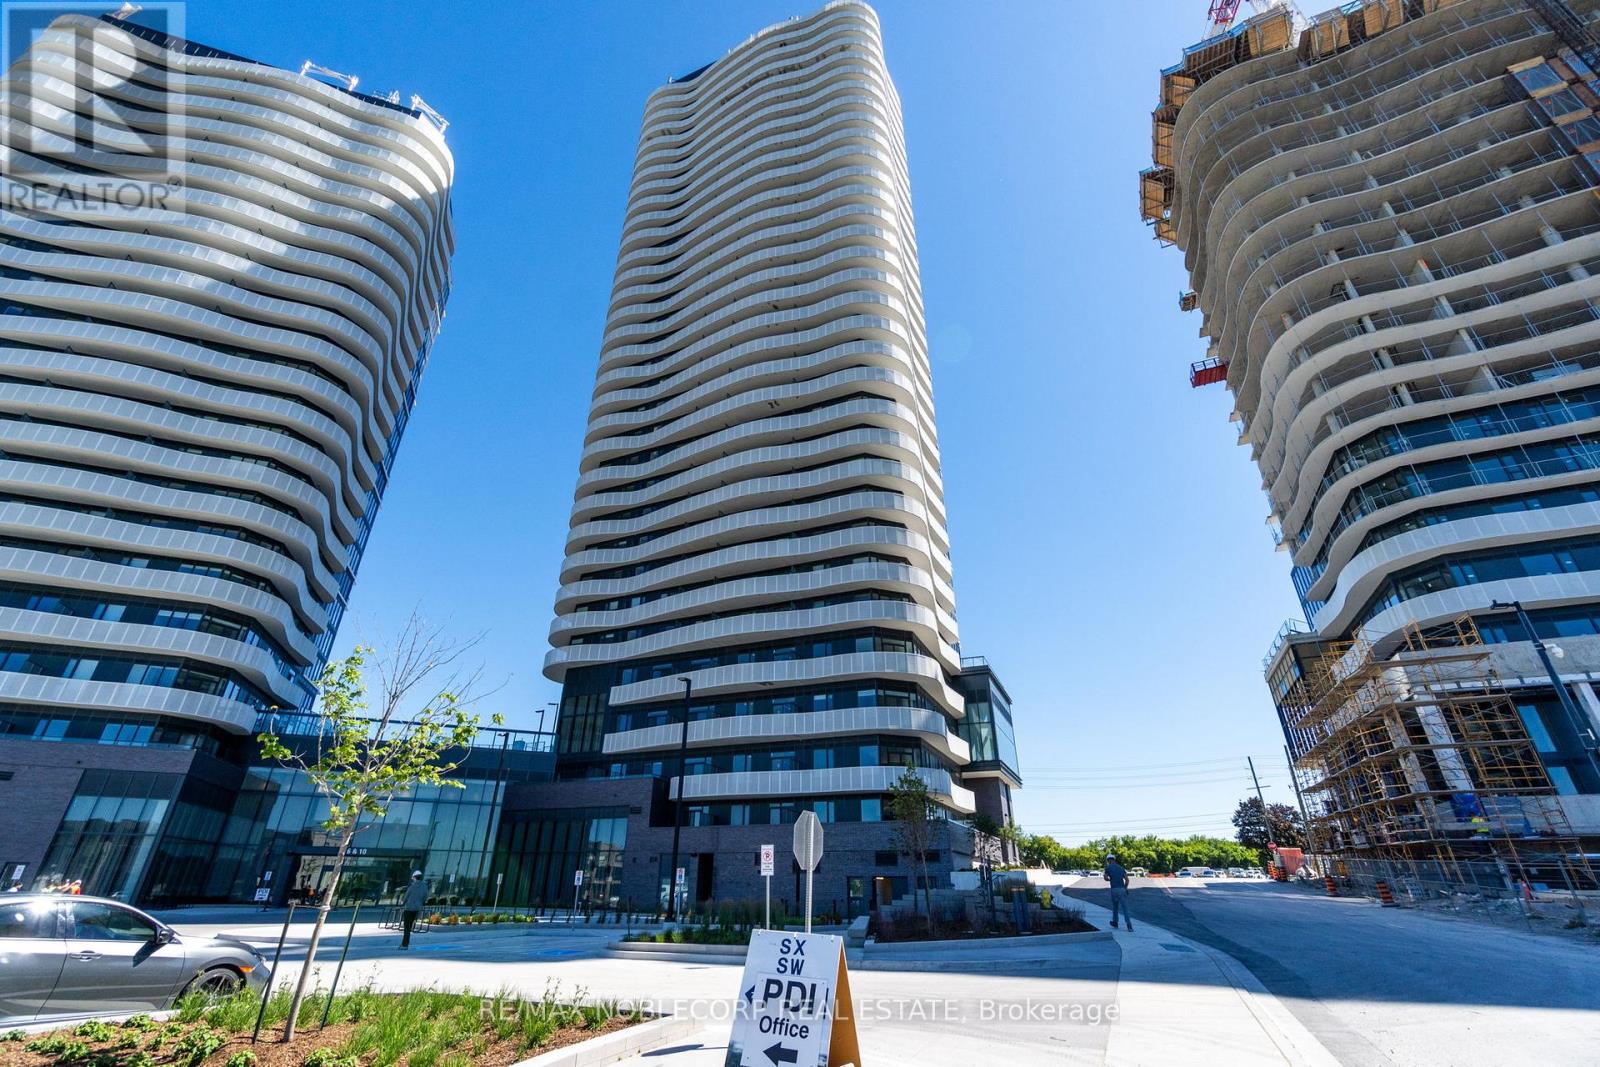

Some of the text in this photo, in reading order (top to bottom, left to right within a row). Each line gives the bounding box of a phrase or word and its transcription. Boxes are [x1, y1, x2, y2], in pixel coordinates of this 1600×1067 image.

[779, 938, 807, 956] SX
[776, 957, 805, 976] SW
[761, 978, 817, 1015] PDI
[759, 1015, 810, 1040] Office
